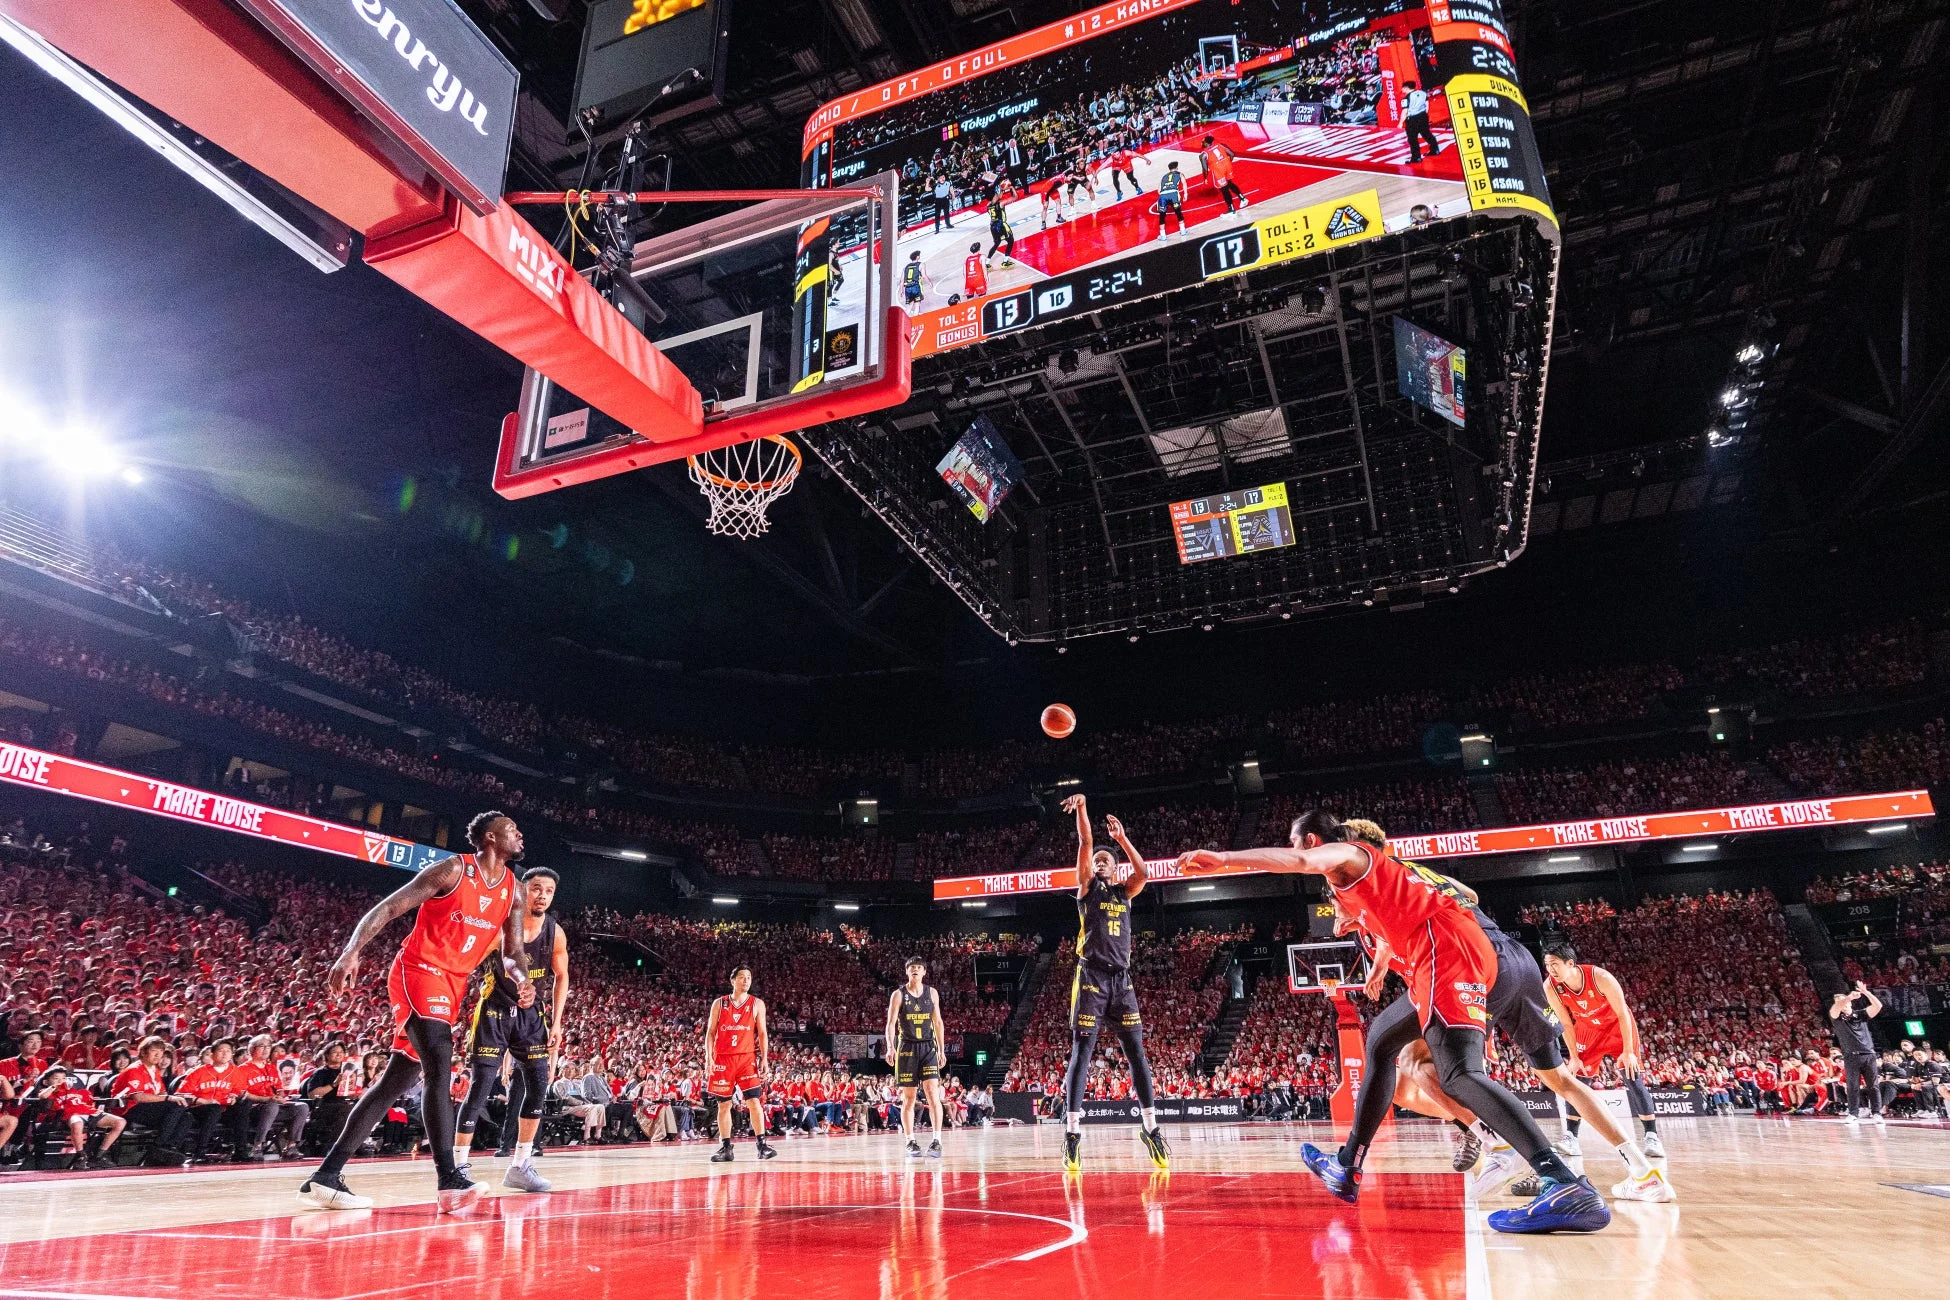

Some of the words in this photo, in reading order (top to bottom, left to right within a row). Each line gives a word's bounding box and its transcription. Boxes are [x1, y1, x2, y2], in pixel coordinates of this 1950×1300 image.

[1308, 27, 1335, 43] Tokyo
[961, 113, 997, 133] Tokyo
[997, 97, 1039, 121] Tenryu
[1477, 116, 1515, 131] FLIPPIN
[1481, 136, 1511, 150] TSUJI
[832, 160, 865, 179] enryu
[1468, 158, 1482, 169] 15
[1486, 156, 1508, 169] EDU
[1473, 179, 1487, 191] 16
[1216, 236, 1245, 269] 17
[1088, 268, 1142, 300] 2:24
[994, 297, 1019, 329] 13
[940, 326, 975, 345] BONUS
[1248, 492, 1259, 504] 17
[1194, 501, 1205, 515] 13
[1219, 502, 1238, 512] 2:24
[153, 782, 206, 818] MAKE
[210, 796, 263, 833] NOISE
[1727, 807, 1779, 829] MAKE
[1780, 801, 1836, 824] NOISE
[1553, 822, 1598, 844] MAKE
[1601, 818, 1651, 840] NOISE
[1393, 839, 1434, 857] MAKE
[1436, 833, 1482, 853] NOISE
[392, 844, 406, 862] 13
[983, 875, 1016, 893] MAKE
[1018, 872, 1053, 889] NOISE
[1316, 905, 1335, 917] 2:24
[1848, 905, 1871, 916] 208
[1107, 920, 1121, 937] 15
[461, 934, 477, 954] 8
[1253, 946, 1268, 955] 210
[997, 961, 1009, 969] 211
[528, 968, 546, 979] OUSE
[731, 1034, 738, 1047] 2
[915, 1027, 923, 1040] 0
[1164, 1107, 1180, 1115] Office
[1203, 1105, 1239, 1116] 日本電技
[1527, 1100, 1553, 1110] Bank
[1087, 1109, 1126, 1117] 金太郎ホーム
